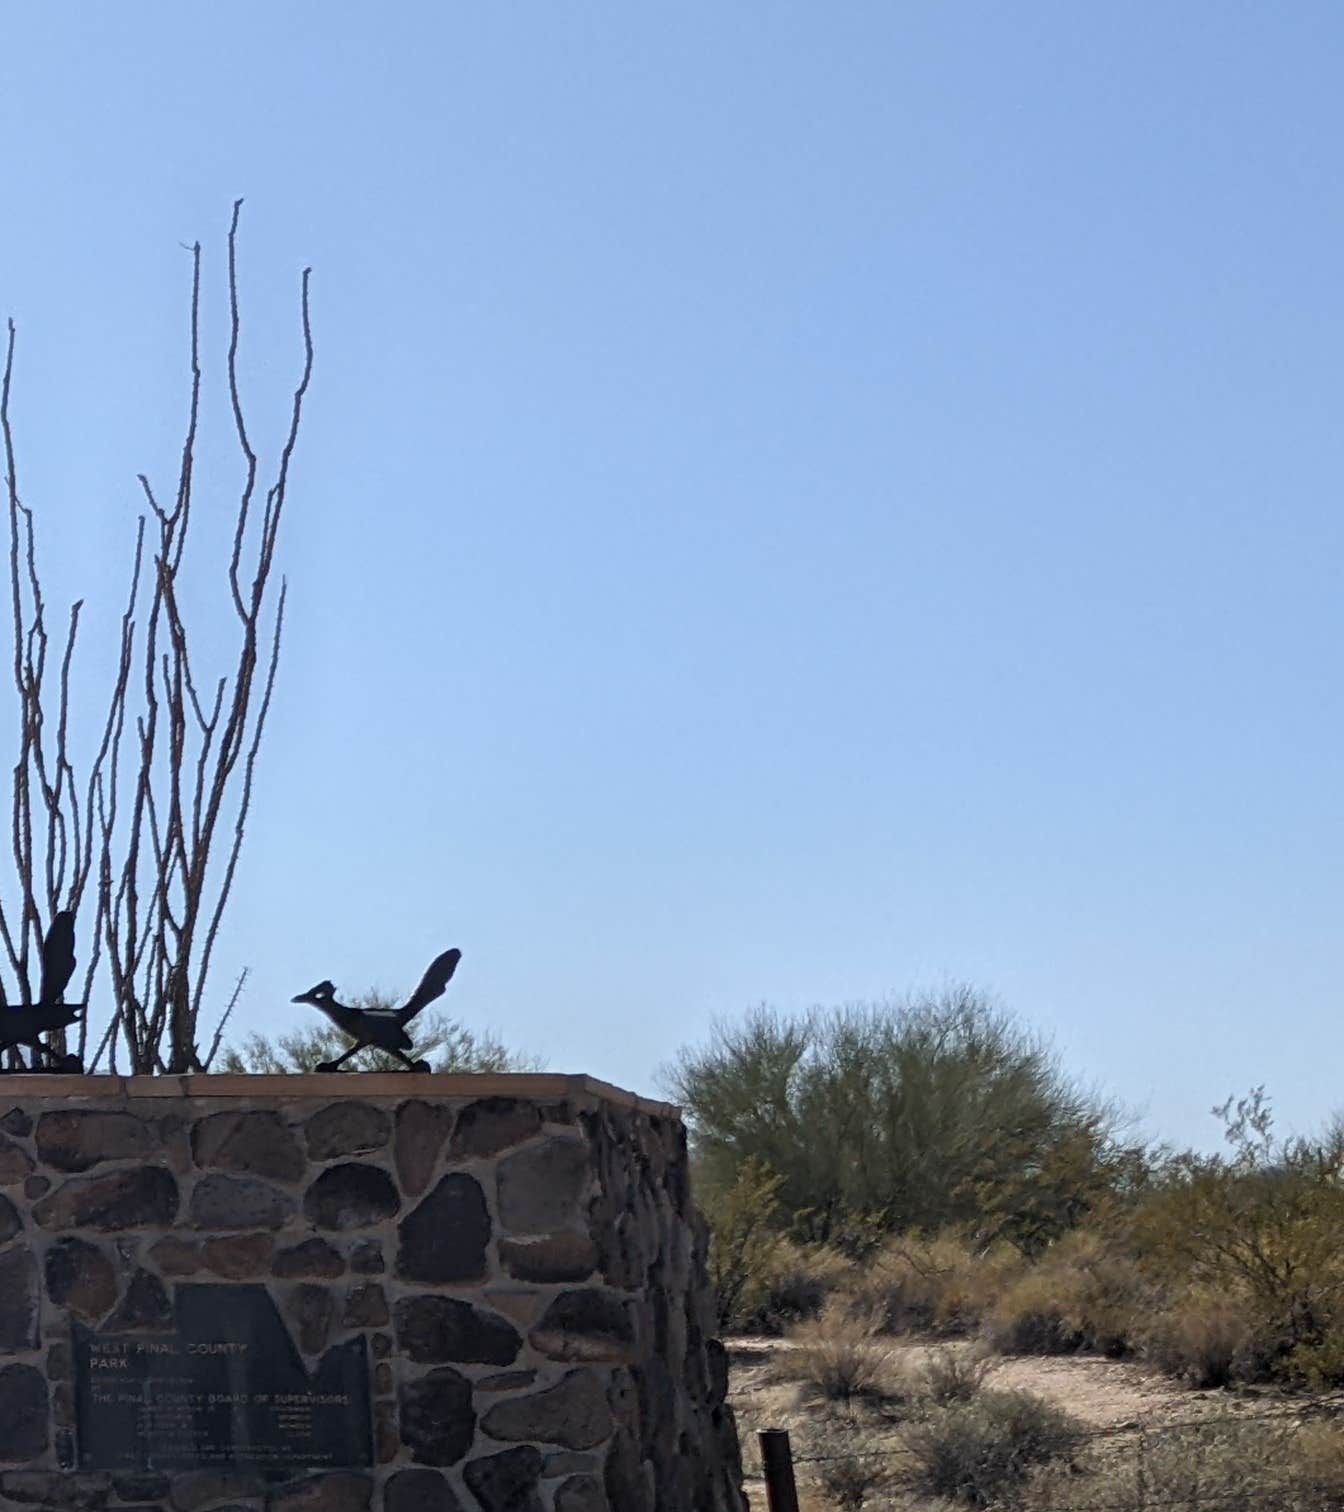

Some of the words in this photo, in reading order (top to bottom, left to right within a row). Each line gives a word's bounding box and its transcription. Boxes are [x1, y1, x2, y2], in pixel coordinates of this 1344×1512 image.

[88, 1343, 128, 1355] WEST
[135, 1343, 179, 1355] PINAL
[188, 1343, 249, 1355] COUNTY
[89, 1358, 128, 1370] PARK
